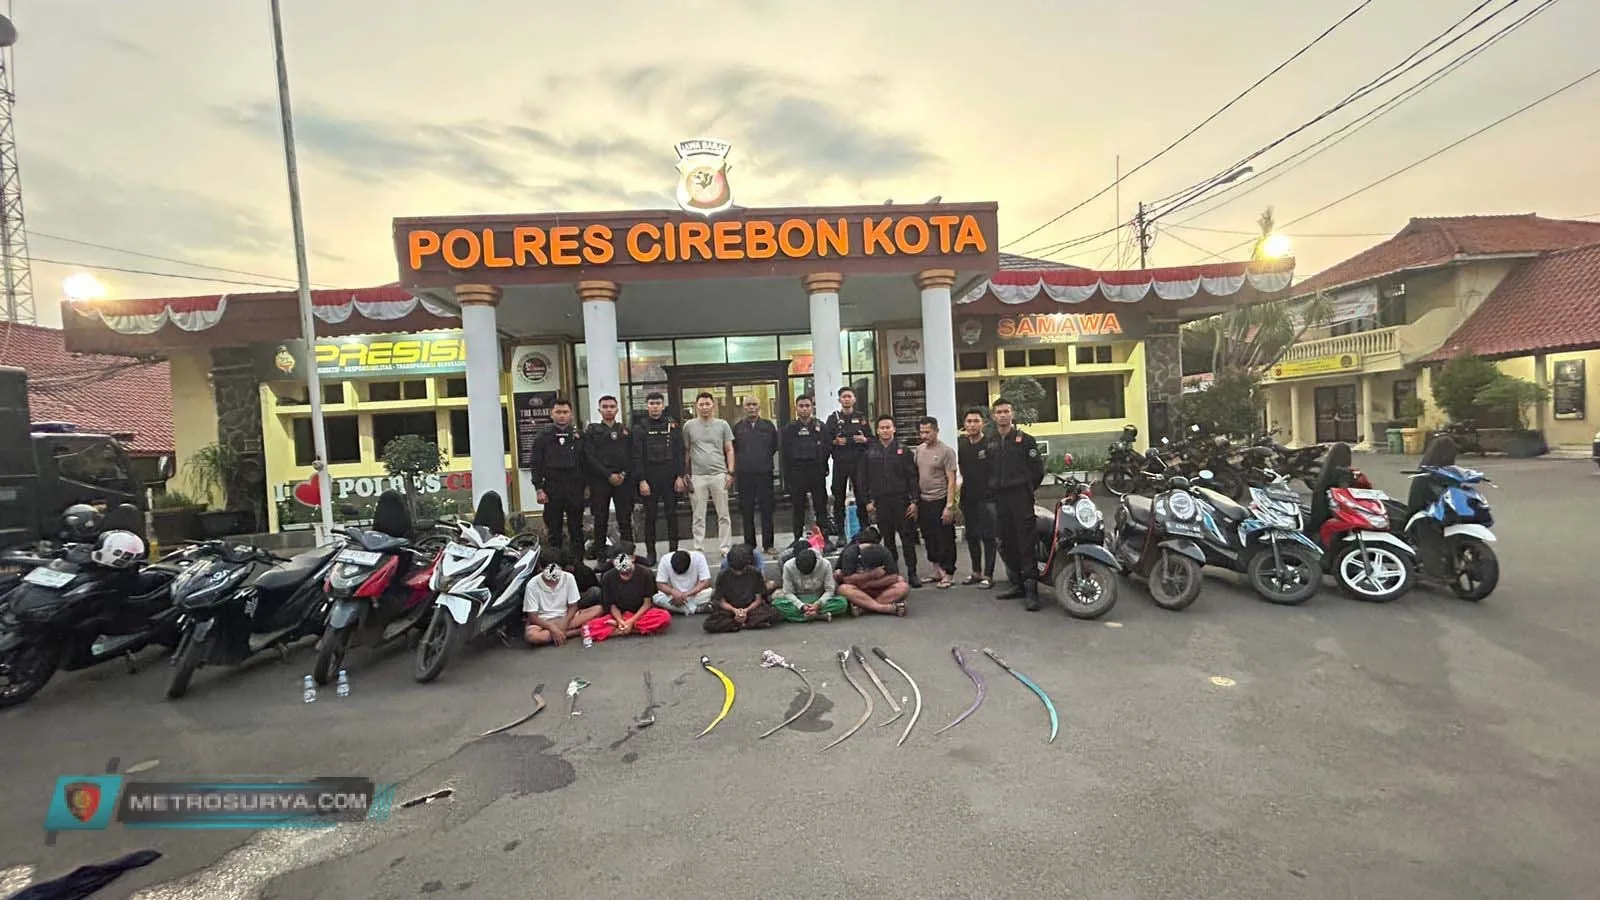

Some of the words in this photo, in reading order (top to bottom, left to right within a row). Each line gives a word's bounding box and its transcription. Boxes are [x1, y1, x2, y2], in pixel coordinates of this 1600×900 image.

[408, 224, 615, 270] POLRES
[626, 217, 848, 263] CIREBON
[863, 214, 987, 255] KOTA
[997, 312, 1123, 338] SAMAWA
[315, 339, 467, 366] PRESISI
